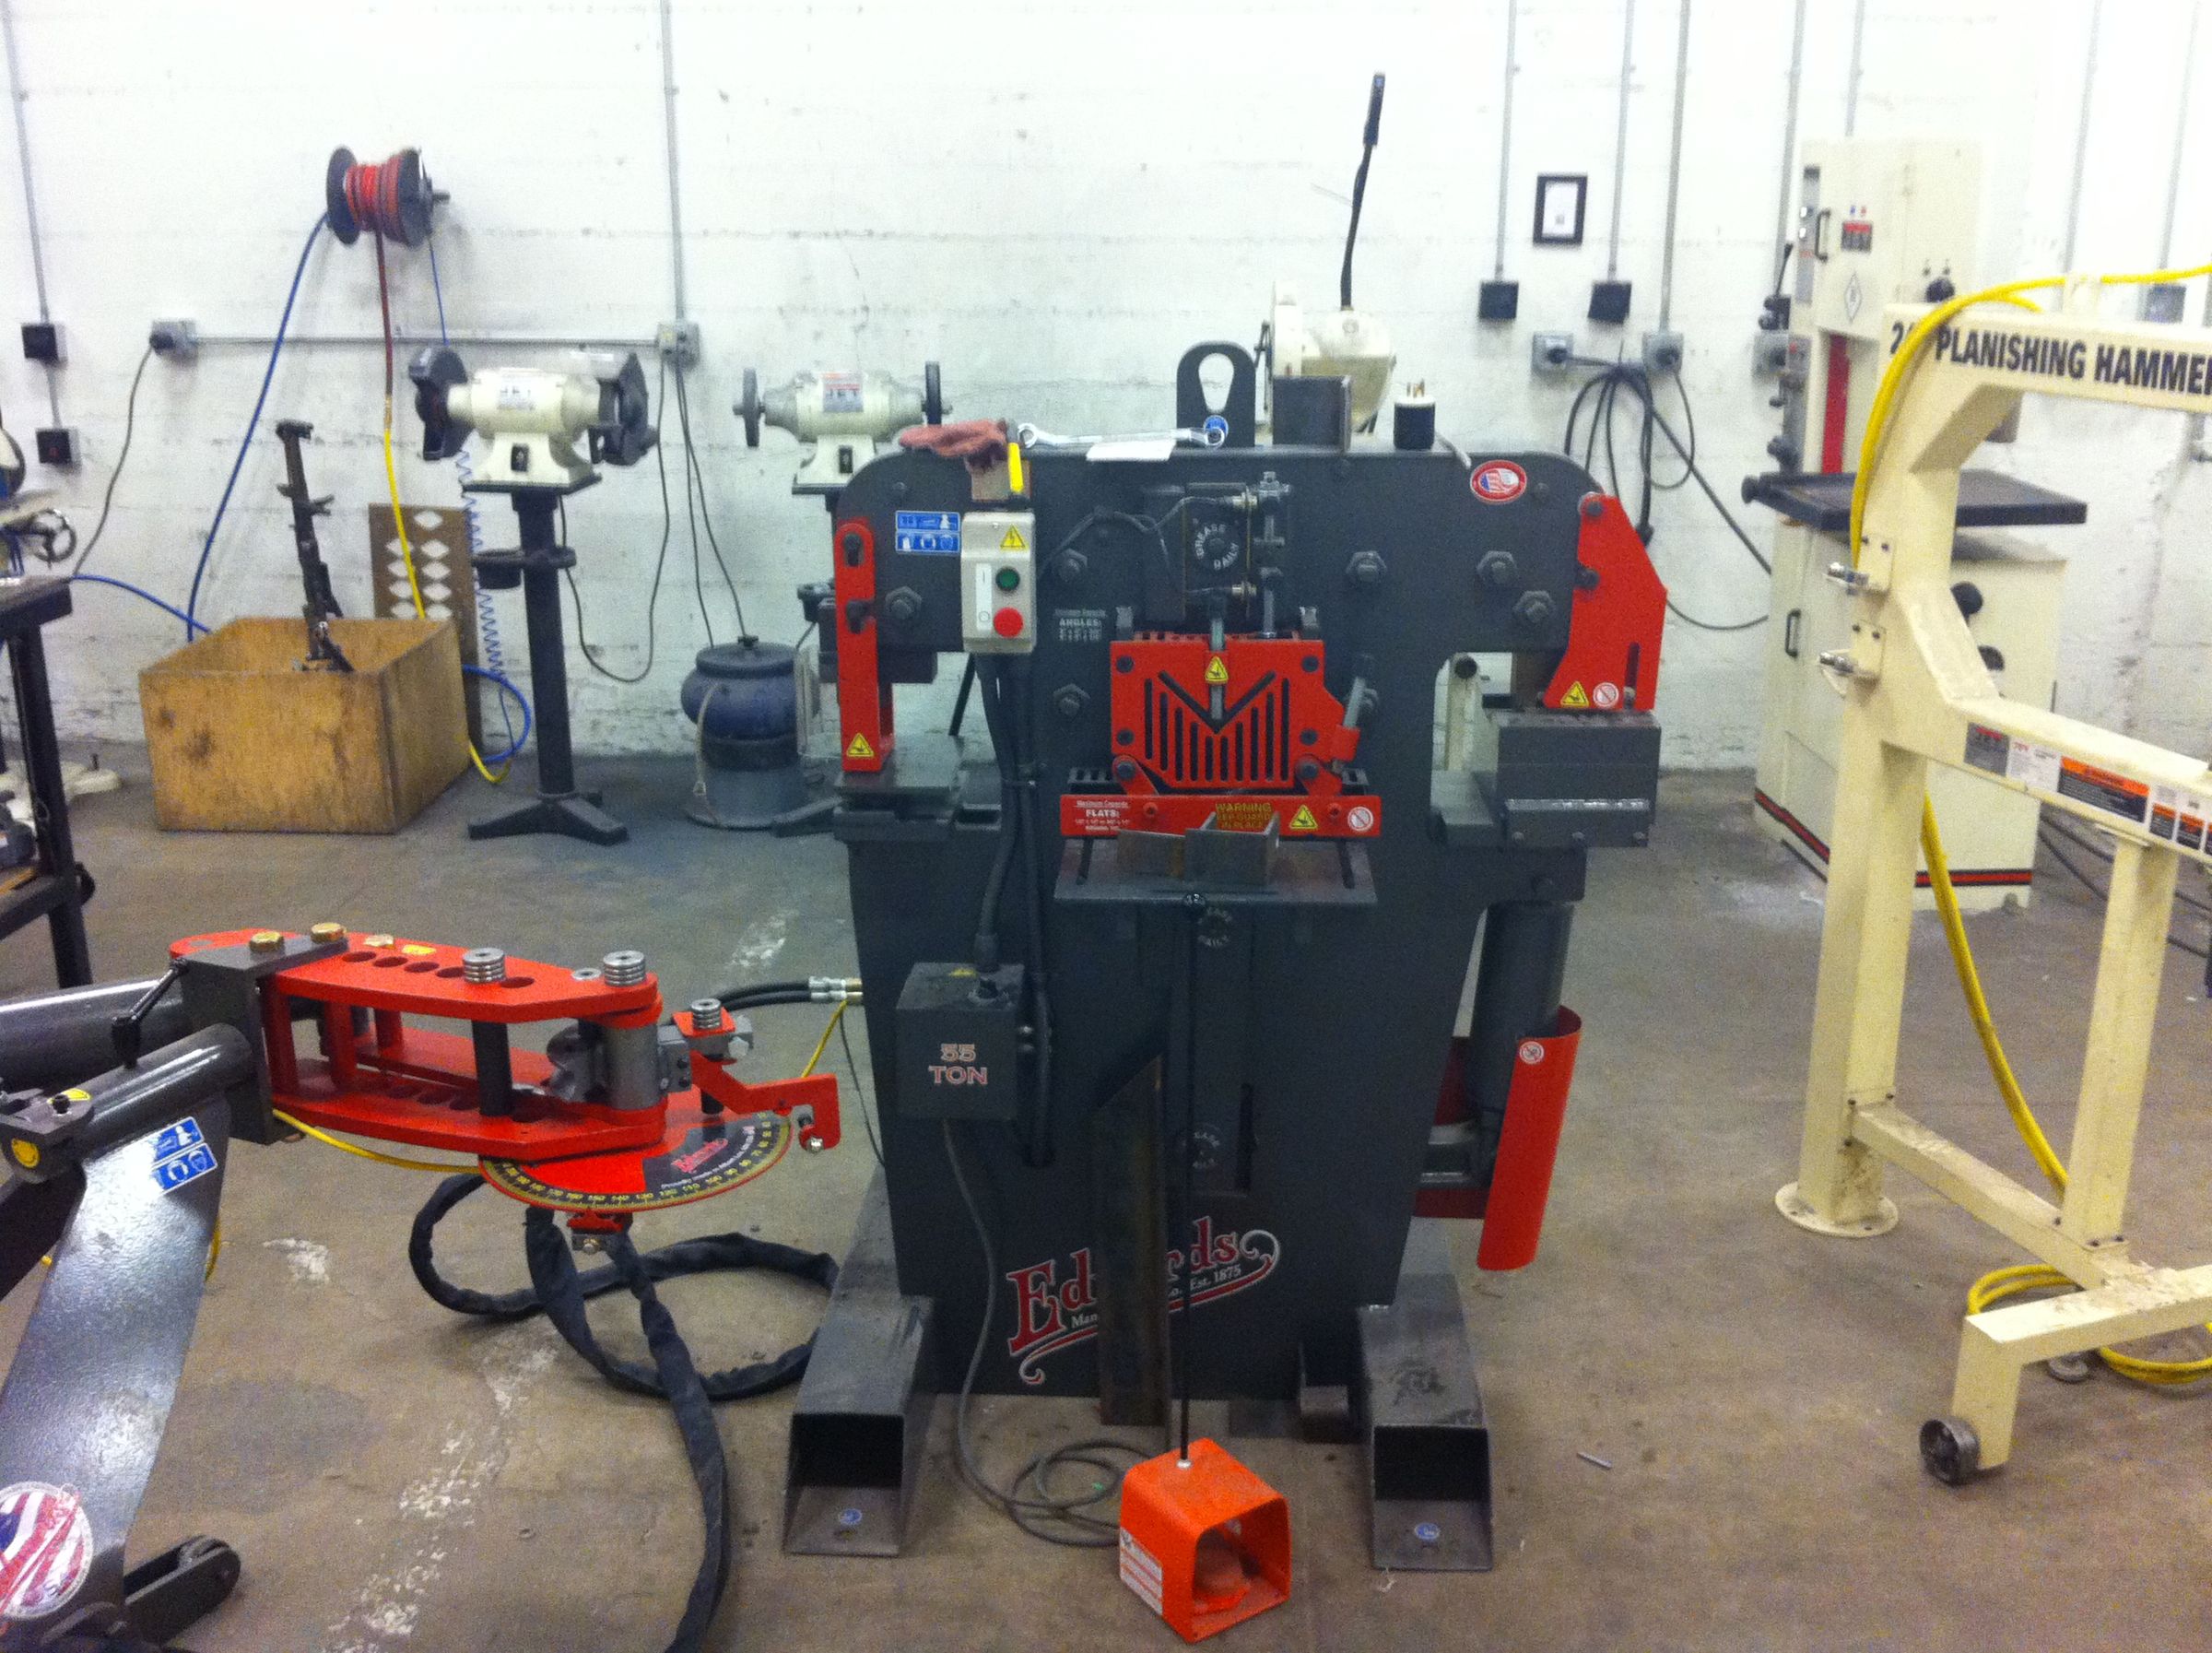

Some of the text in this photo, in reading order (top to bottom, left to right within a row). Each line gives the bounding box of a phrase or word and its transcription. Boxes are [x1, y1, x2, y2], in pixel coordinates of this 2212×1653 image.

[1936, 324, 2087, 381] PLANISHING
[1216, 802, 1271, 811] WARNING
[940, 1043, 976, 1061] 55
[928, 1065, 988, 1085] TON
[1213, 1264, 1242, 1282] 1875
